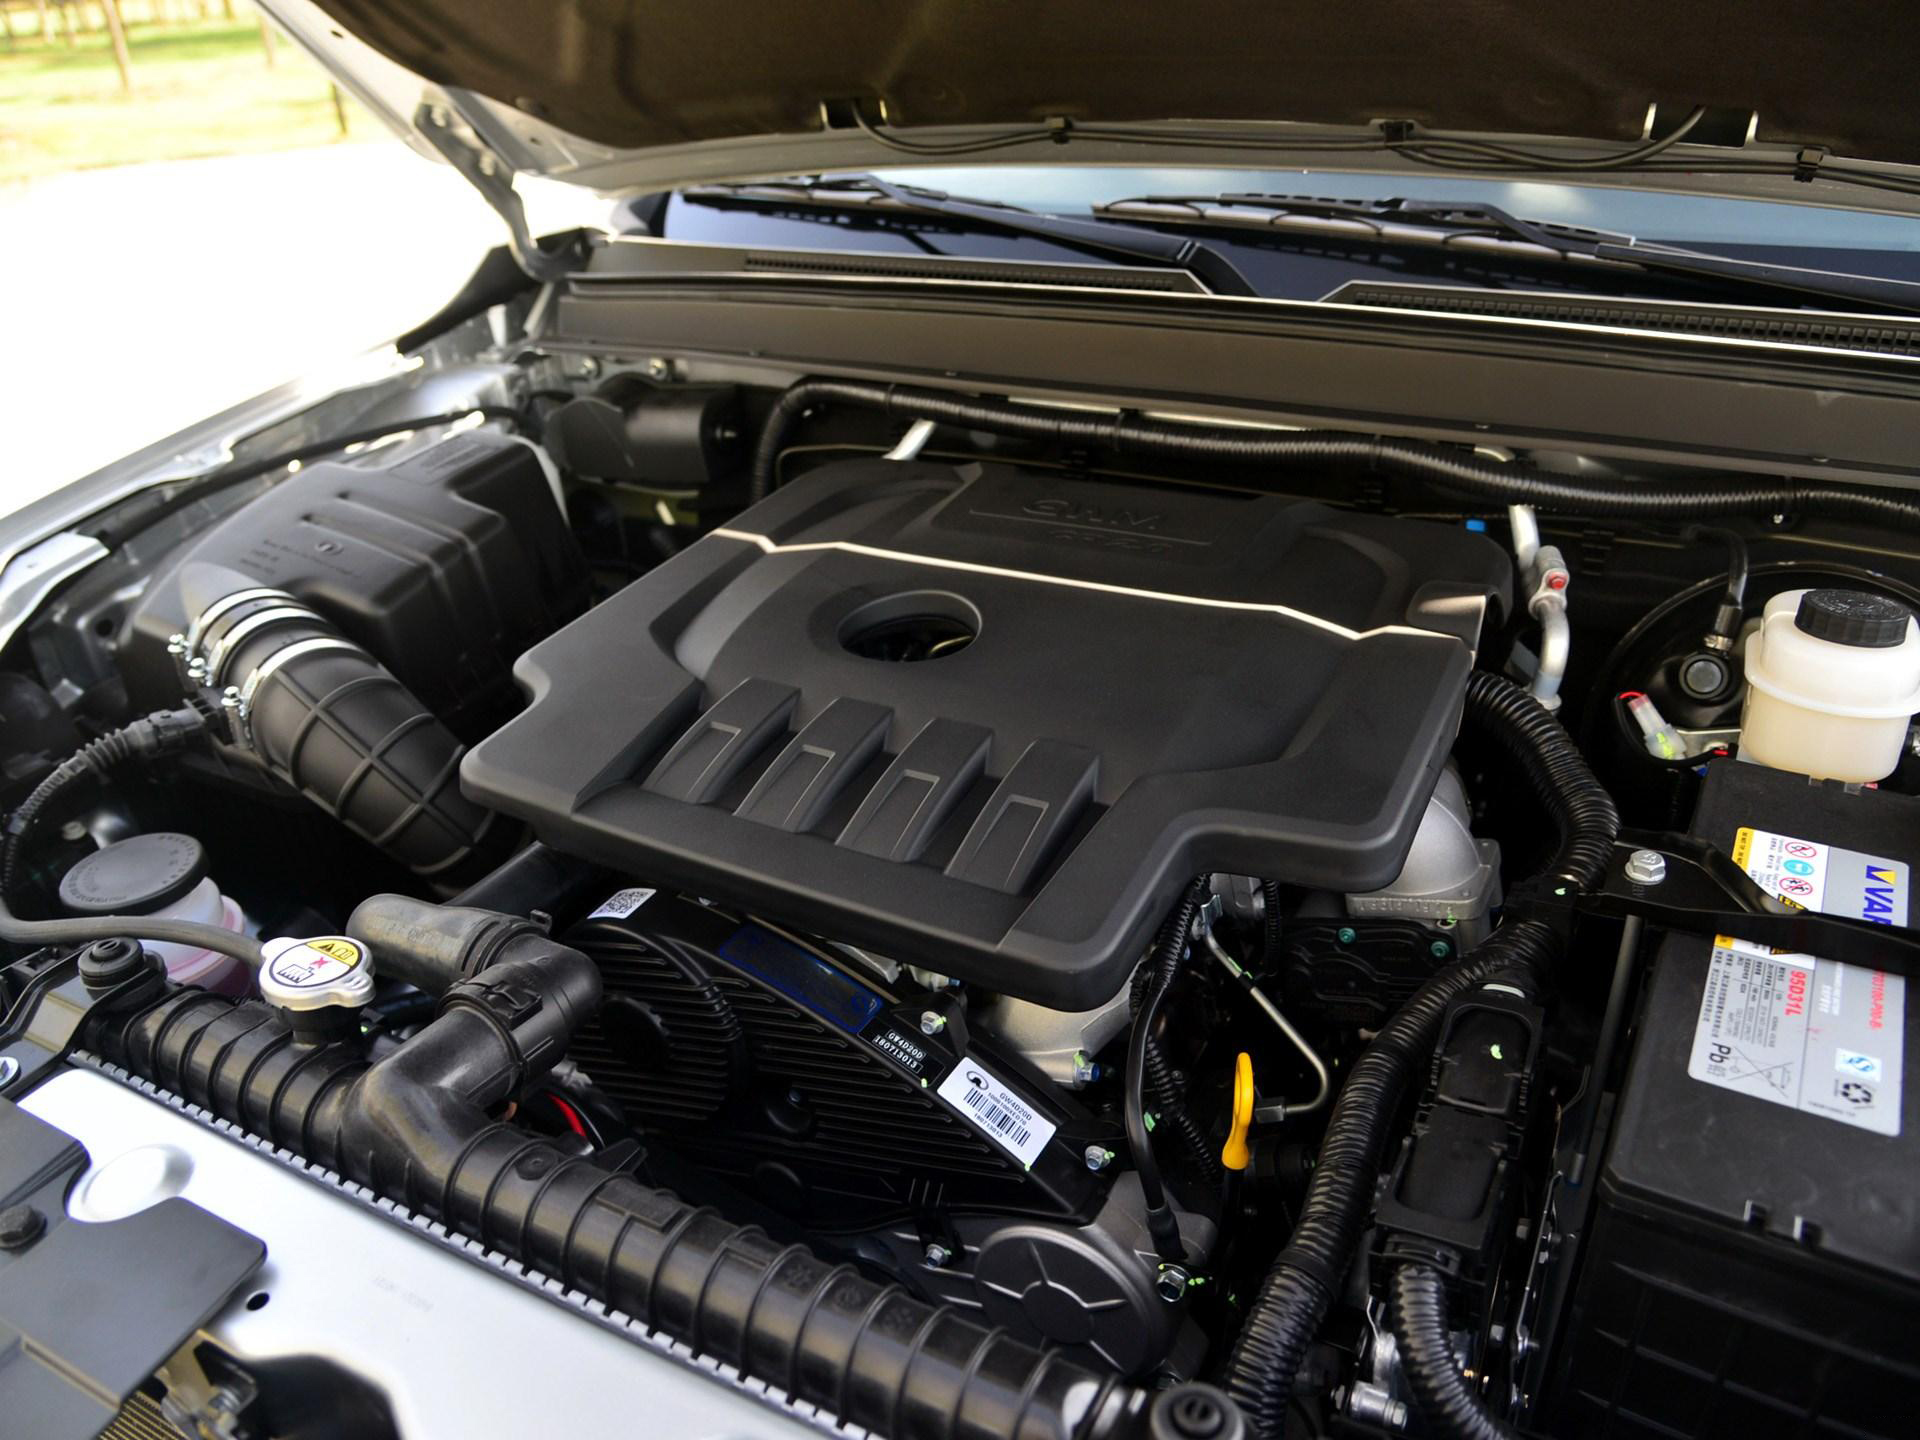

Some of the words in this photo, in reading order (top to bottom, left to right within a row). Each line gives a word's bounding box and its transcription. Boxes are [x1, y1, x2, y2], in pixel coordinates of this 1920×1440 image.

[1785, 970, 1807, 1016] 95D31L
[874, 1035, 918, 1069] 180713013
[888, 1032, 923, 1059] GW4D20D
[1708, 1042, 1731, 1064] Pb
[999, 1092, 1033, 1121] GW4D20D
